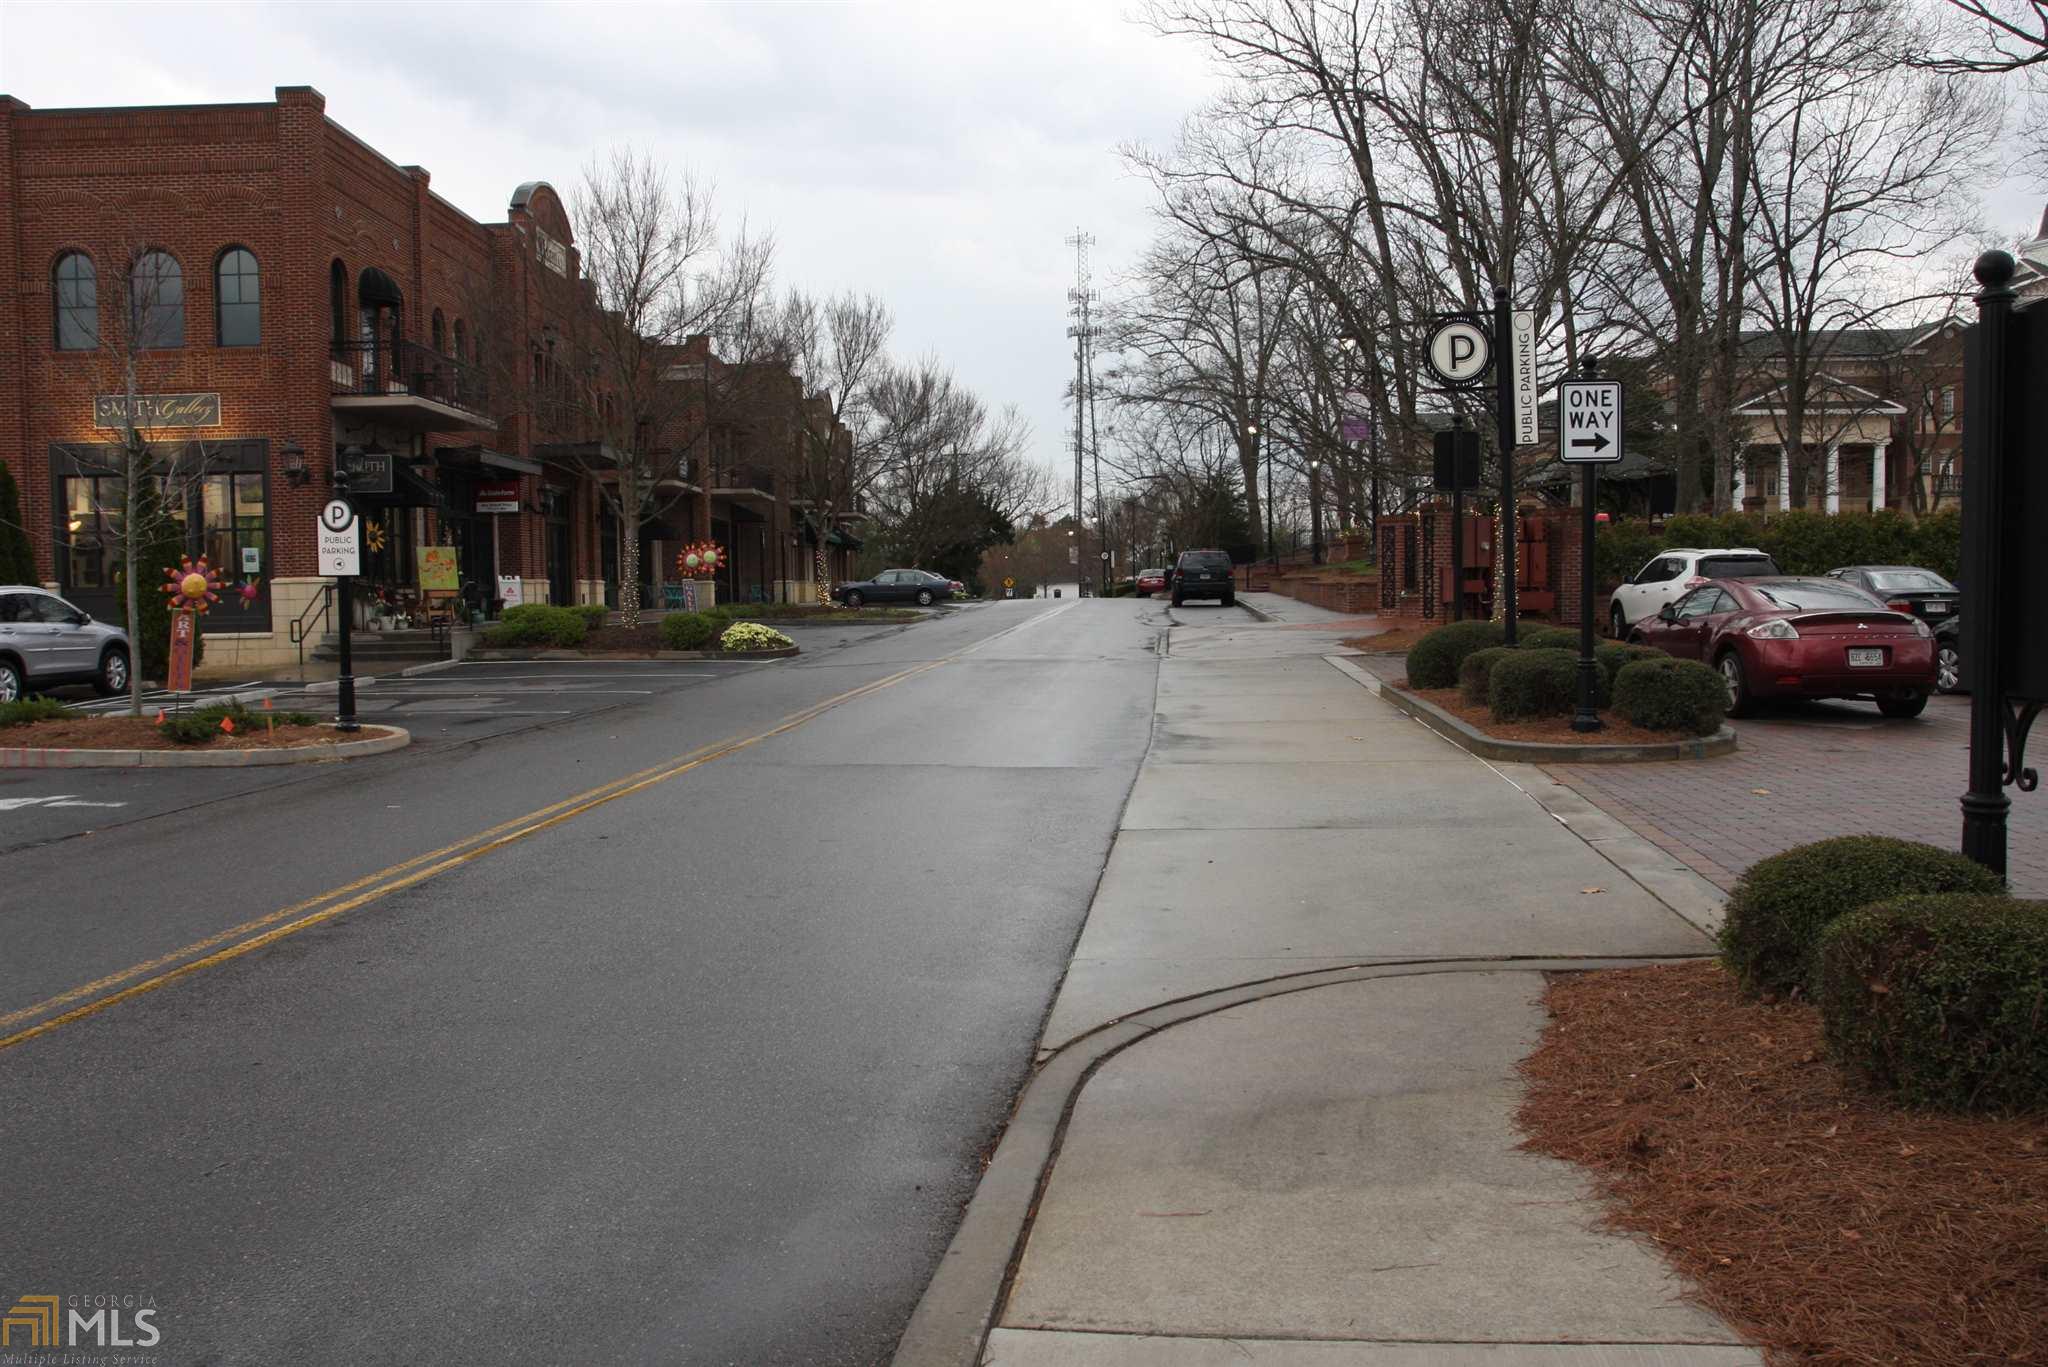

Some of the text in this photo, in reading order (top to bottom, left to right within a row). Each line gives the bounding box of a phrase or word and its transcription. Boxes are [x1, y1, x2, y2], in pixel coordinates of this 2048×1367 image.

[1450, 334, 1475, 370] P
[1519, 333, 1533, 443] PUBLIC PARKING
[1570, 390, 1612, 407] ONE
[100, 400, 160, 417] SMTH
[1569, 411, 1613, 428] WAY
[332, 506, 344, 523] P
[325, 536, 352, 544] PUBLIC
[321, 547, 355, 555] PARKING
